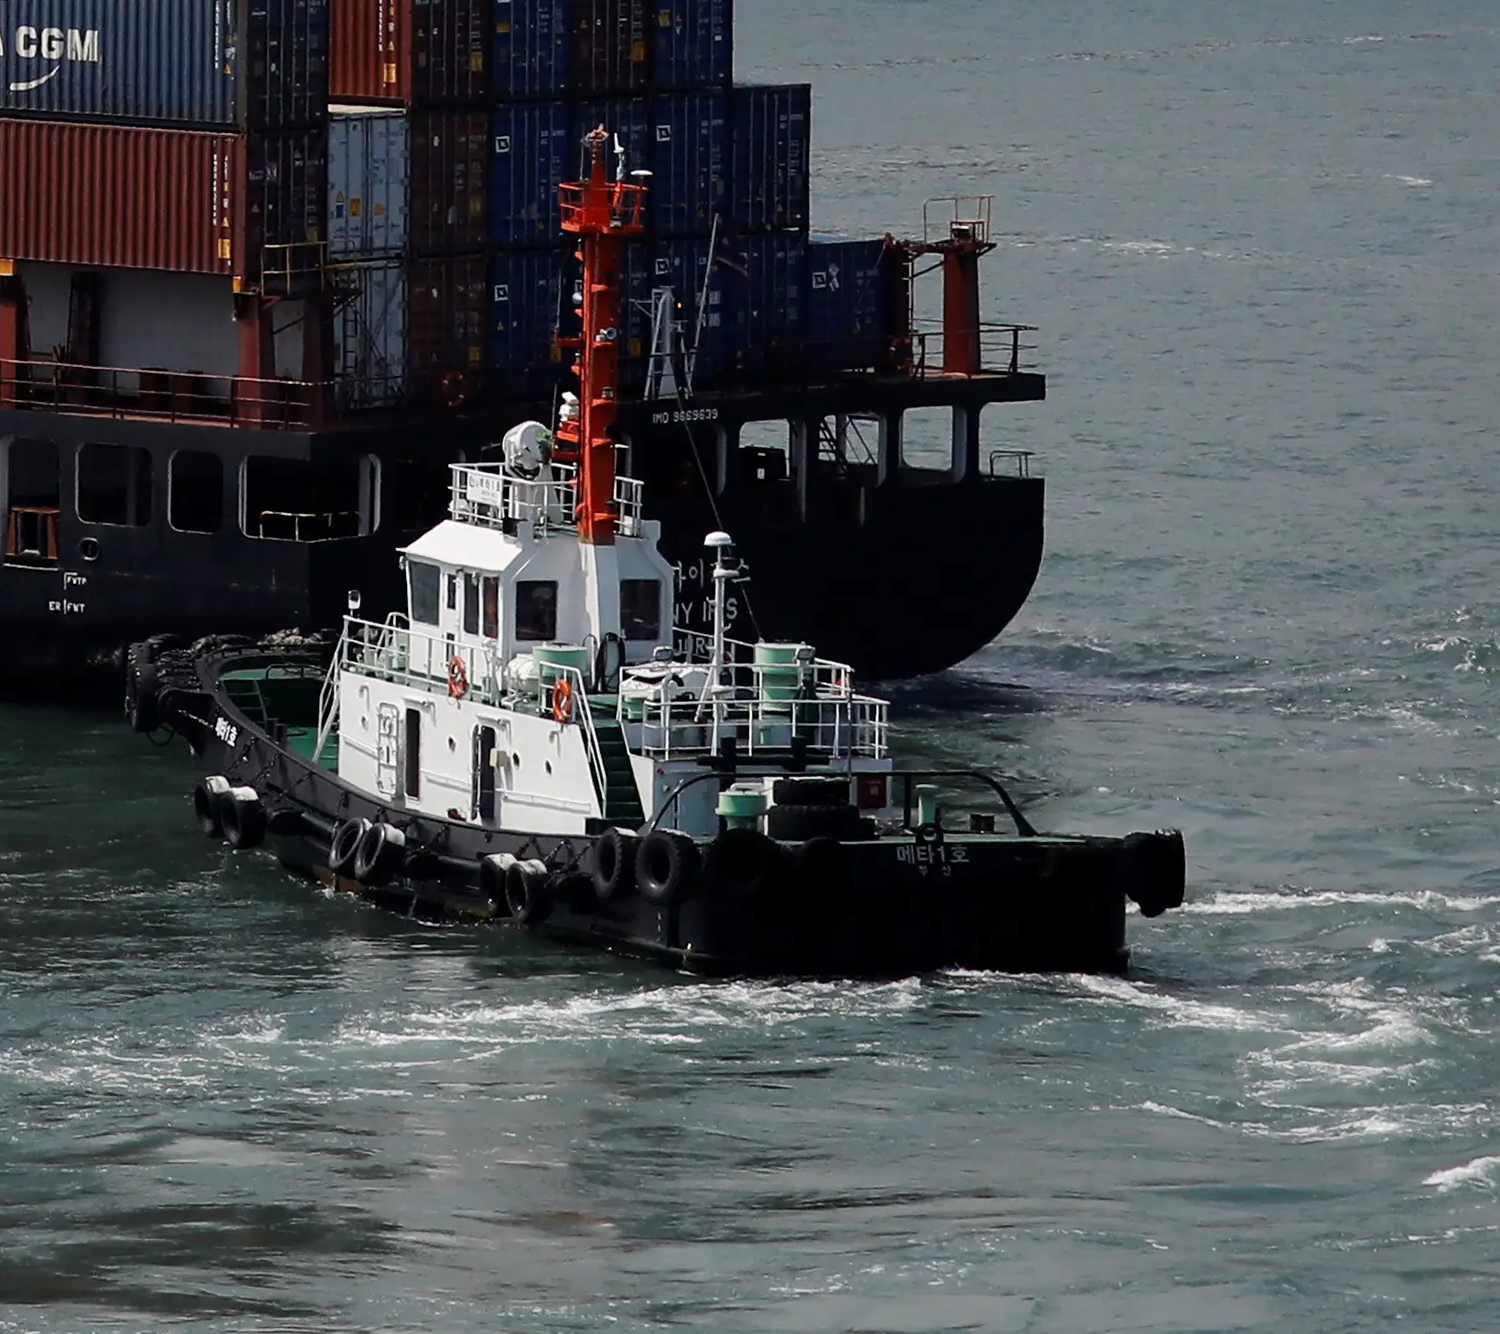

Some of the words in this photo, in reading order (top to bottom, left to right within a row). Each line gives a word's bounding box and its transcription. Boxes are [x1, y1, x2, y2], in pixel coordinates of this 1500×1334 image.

[16, 25, 98, 62] CGM
[652, 412, 669, 424] IMO
[702, 598, 738, 622] IRS
[896, 843, 970, 865] 메타1호
